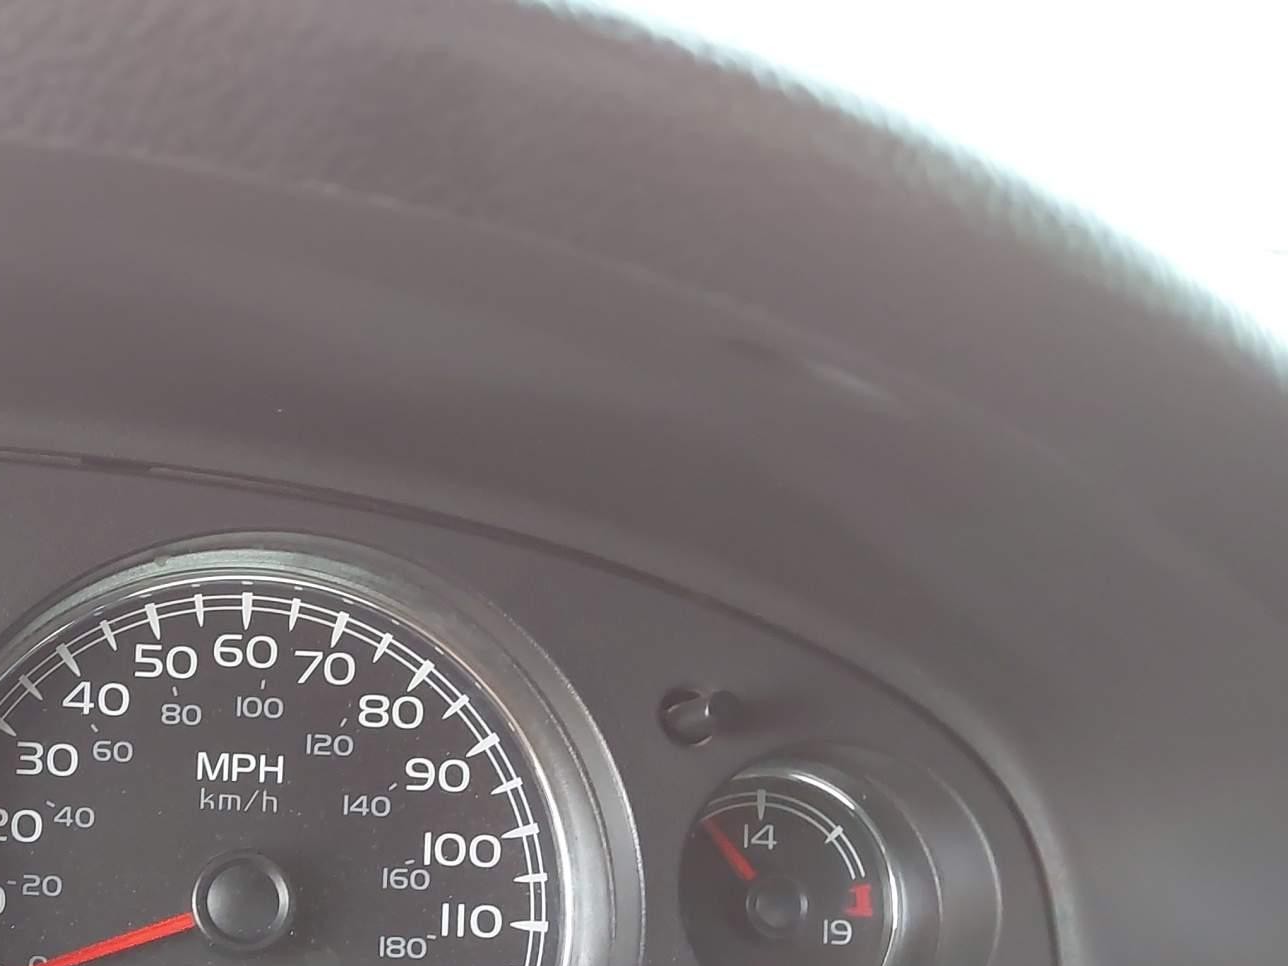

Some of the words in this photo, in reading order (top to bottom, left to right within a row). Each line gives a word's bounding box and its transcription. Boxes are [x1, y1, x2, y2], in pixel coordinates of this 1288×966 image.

[134, 644, 198, 679] 50
[213, 635, 278, 668] 60
[293, 651, 356, 685] 70
[62, 683, 130, 716] 40
[235, 697, 284, 719] 100
[357, 695, 424, 729] 80
[161, 703, 202, 726] 80
[92, 741, 133, 763] 60
[305, 734, 354, 756] 120
[16, 743, 79, 776] 30
[196, 751, 285, 783] MPH
[404, 759, 471, 792] 90
[199, 789, 279, 814] km/h
[342, 795, 391, 816] 140
[54, 806, 95, 828] 40
[423, 833, 501, 867] 100
[742, 824, 777, 850] 14
[22, 874, 63, 896] 20
[382, 868, 430, 891] 160
[440, 905, 503, 938] 110
[822, 920, 852, 946] 19
[378, 937, 427, 959] 180
